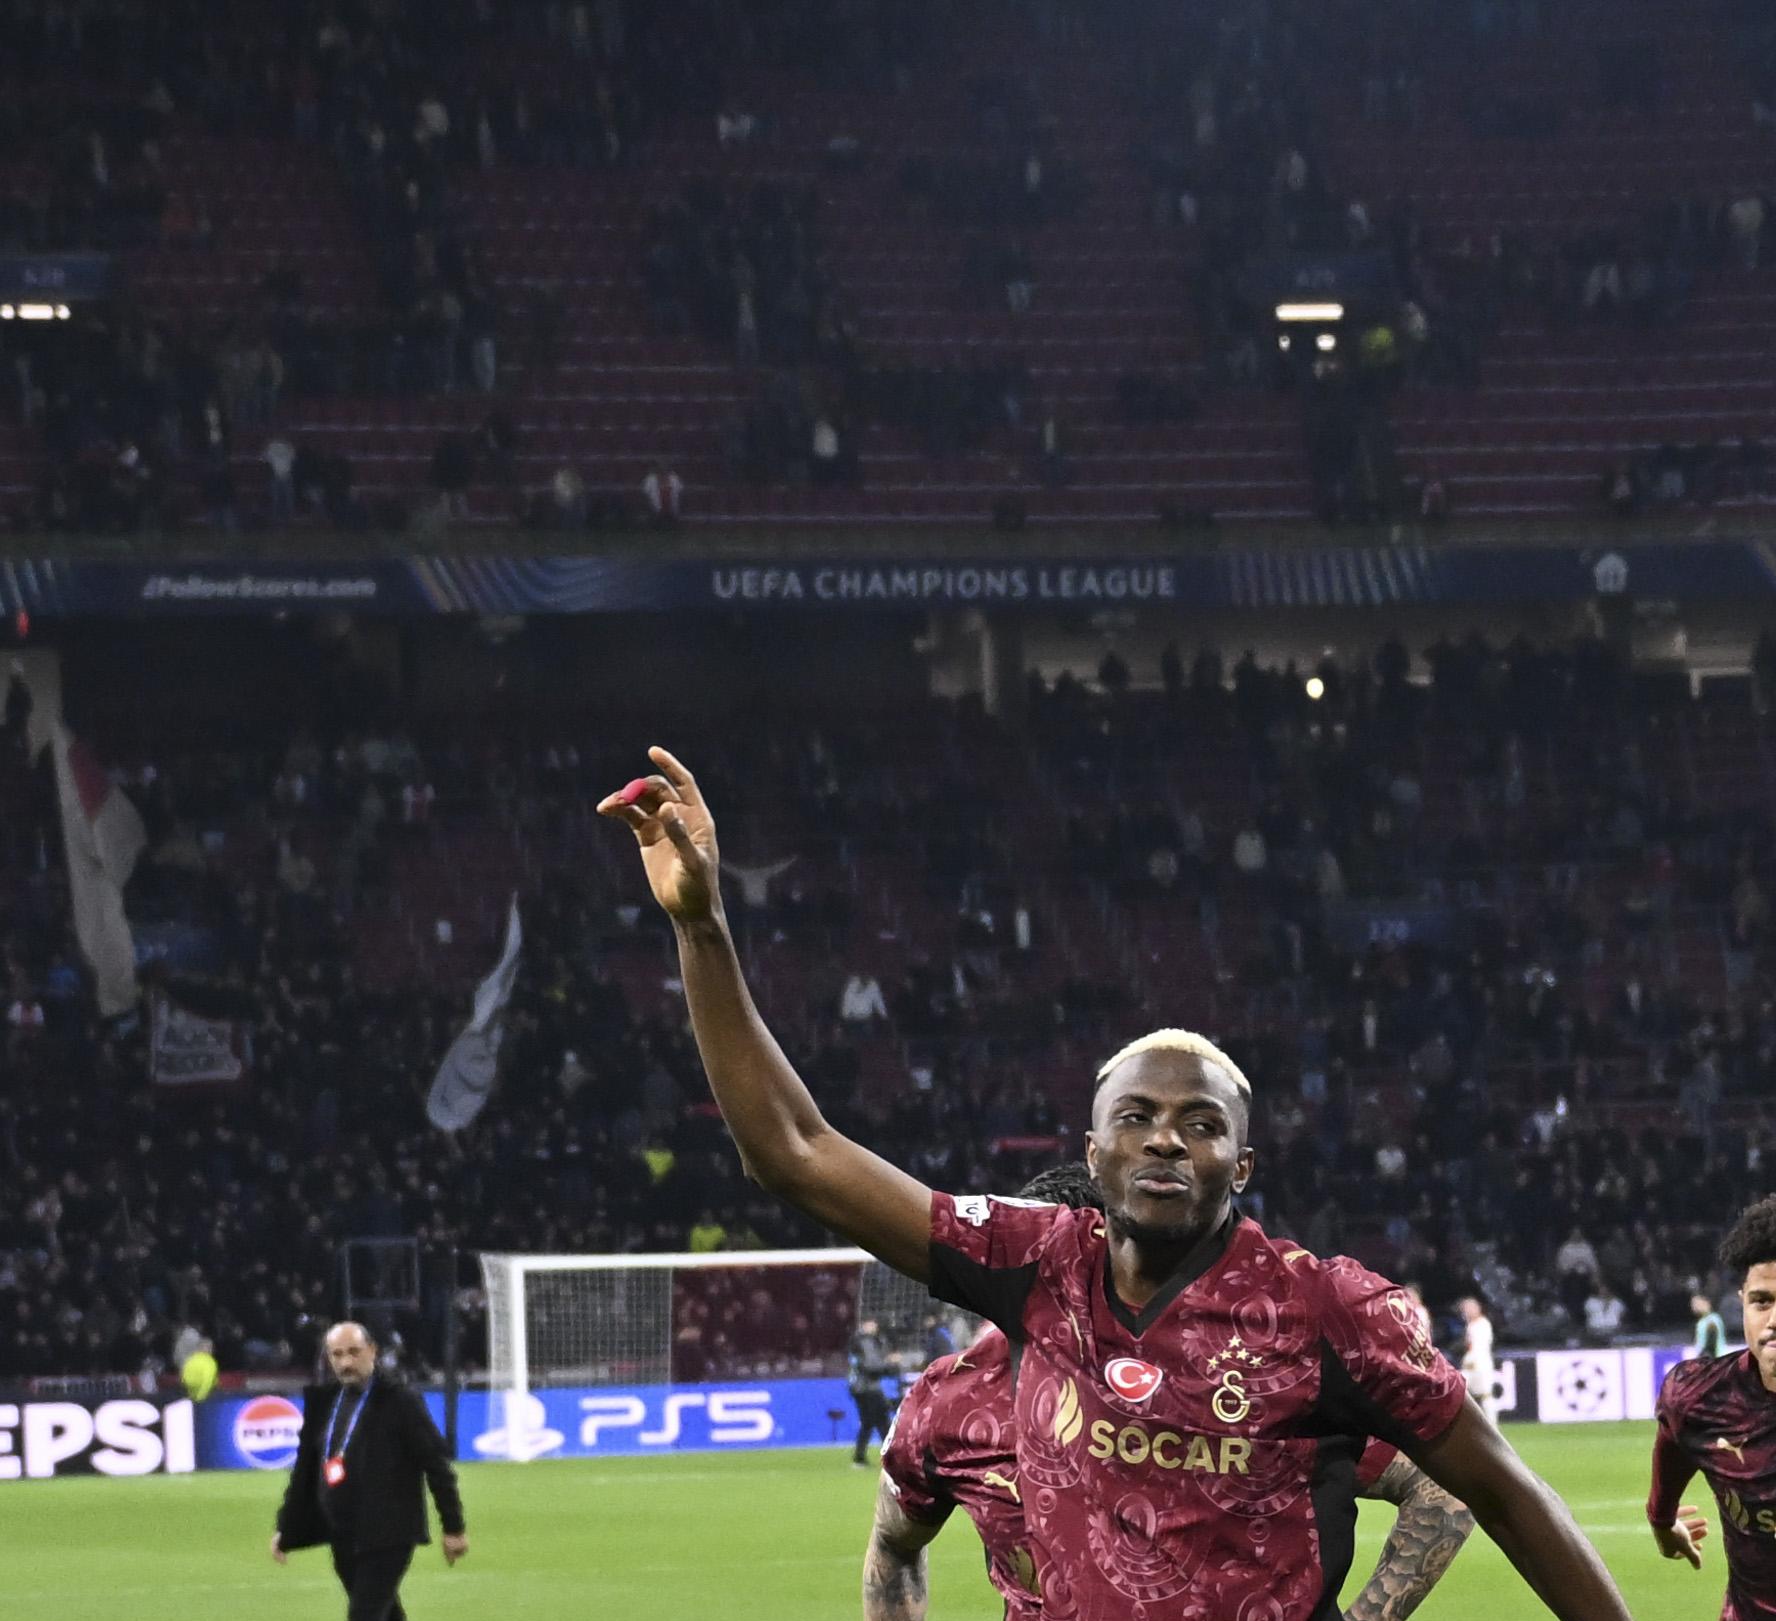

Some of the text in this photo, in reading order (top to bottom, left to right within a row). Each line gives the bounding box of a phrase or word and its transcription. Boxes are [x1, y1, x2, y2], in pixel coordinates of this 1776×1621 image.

[712, 567, 1176, 598] UEFA CHAMPIONS LEAGUE
[579, 1390, 774, 1446] PS5
[1088, 1420, 1252, 1474] SOCAR
